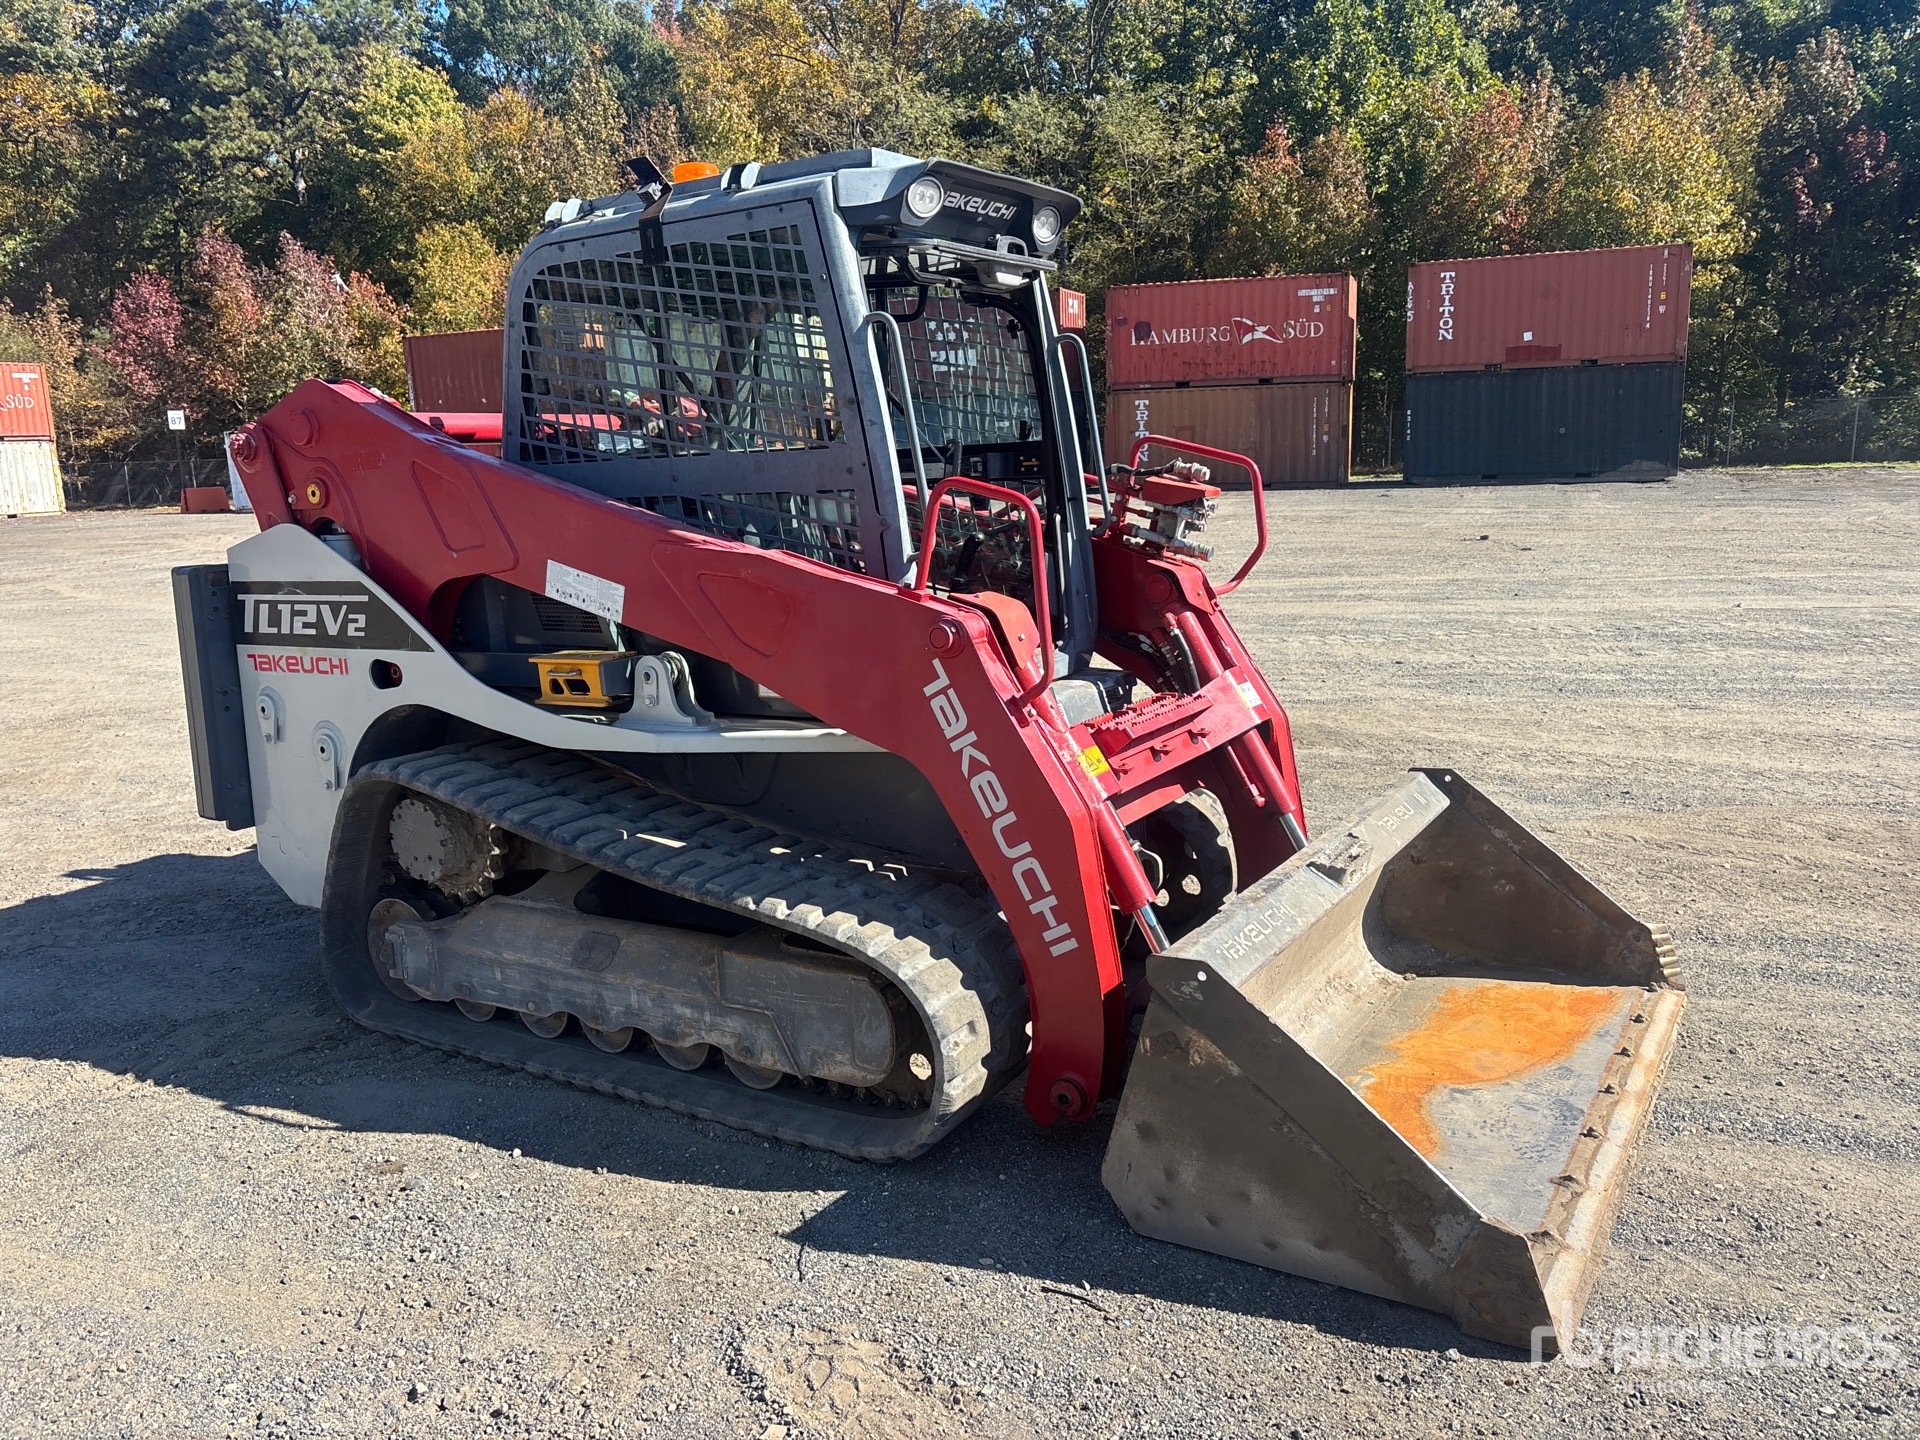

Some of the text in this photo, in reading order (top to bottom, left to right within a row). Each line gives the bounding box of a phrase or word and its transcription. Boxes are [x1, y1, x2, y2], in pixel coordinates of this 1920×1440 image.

[1438, 271, 1456, 341] TRITON
[1283, 318, 1325, 339] SÜD
[170, 416, 182, 425] 87
[237, 594, 369, 637] TL12V2
[246, 653, 350, 676] TAKEUCHI
[922, 657, 1079, 957] TAKEUCHI
